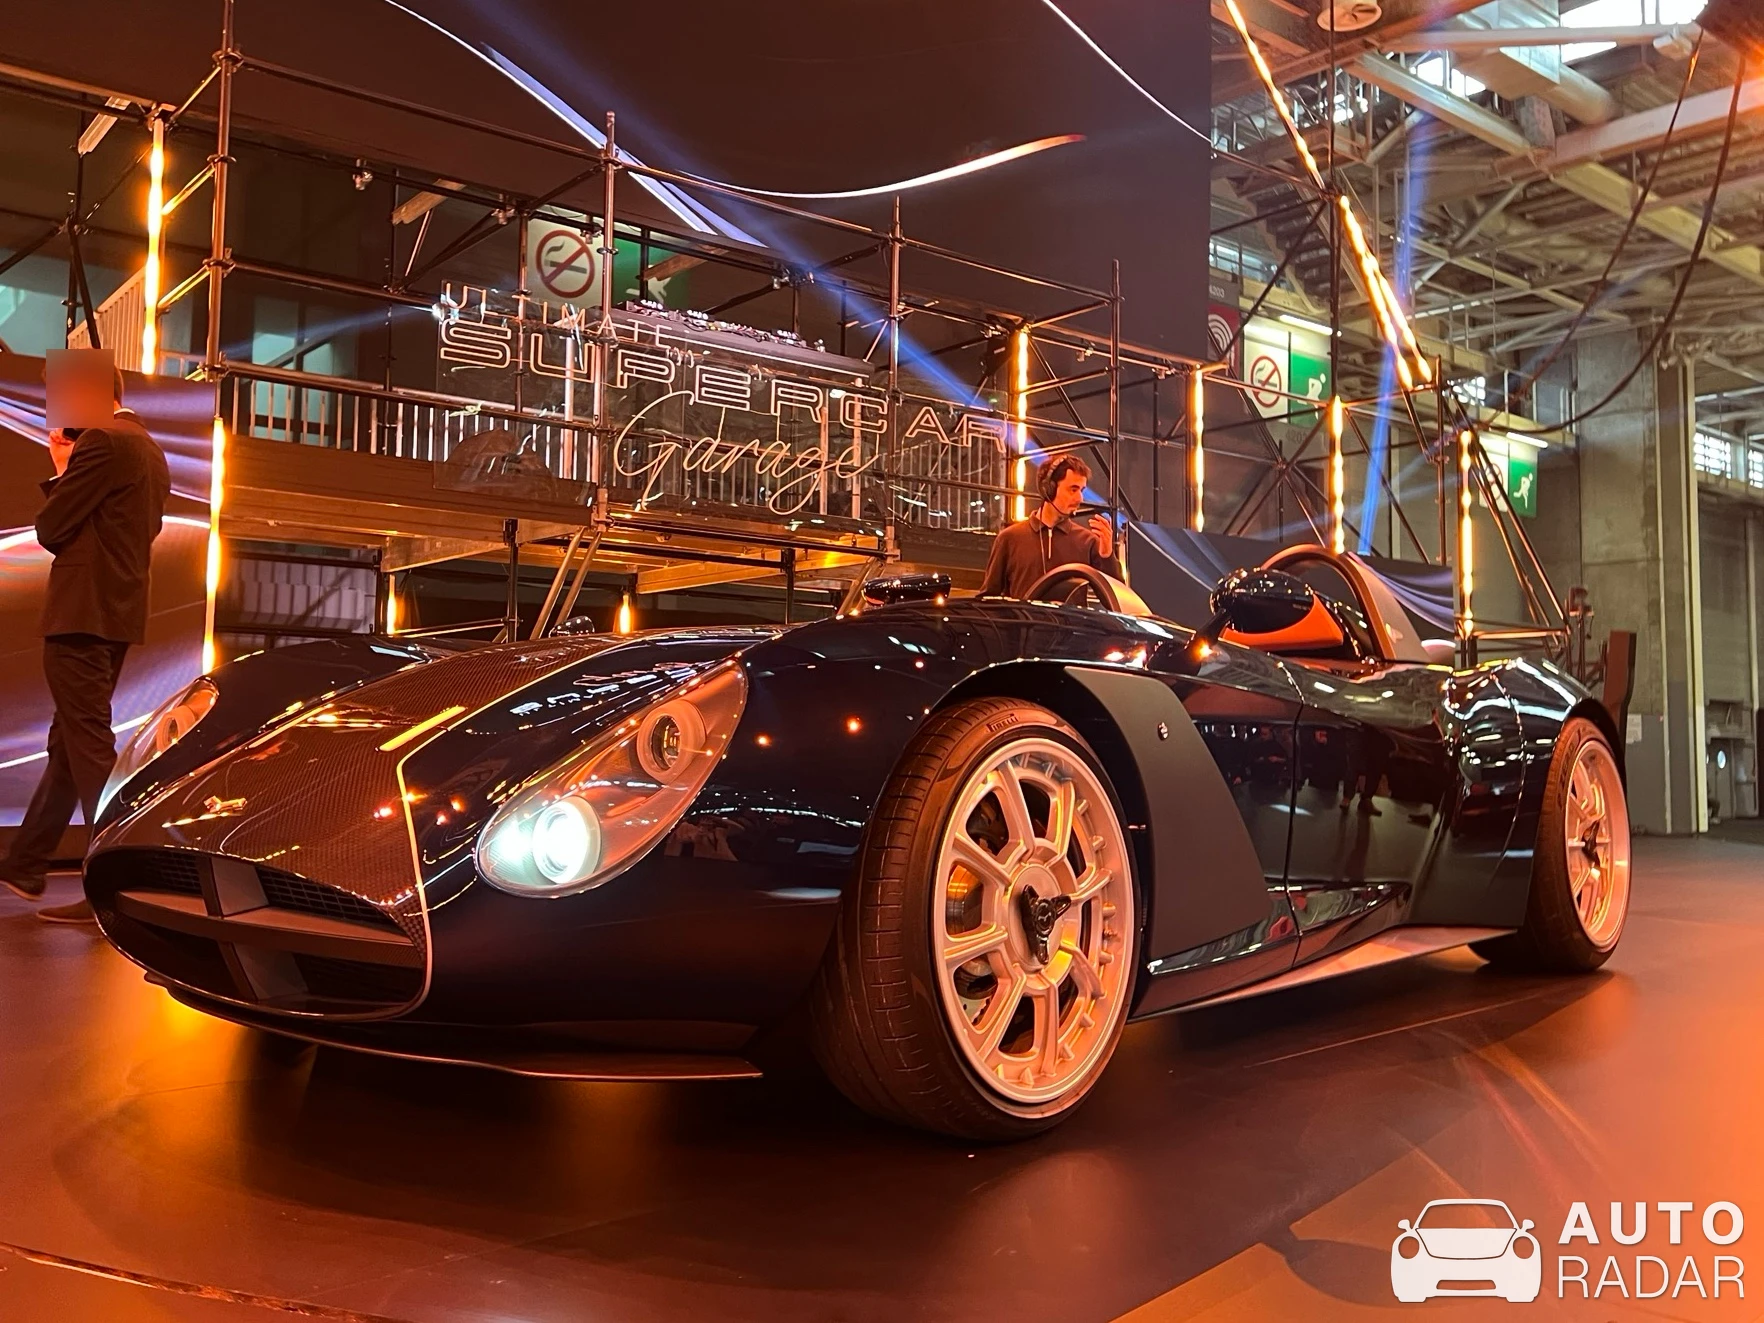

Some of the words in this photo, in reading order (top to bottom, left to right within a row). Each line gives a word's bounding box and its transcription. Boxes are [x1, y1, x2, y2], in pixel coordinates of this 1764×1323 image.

[446, 282, 672, 350] ULTIMATE
[440, 317, 1008, 454] SUPERCAR
[613, 391, 879, 515] Garage
[986, 713, 1019, 732] PIRELLI
